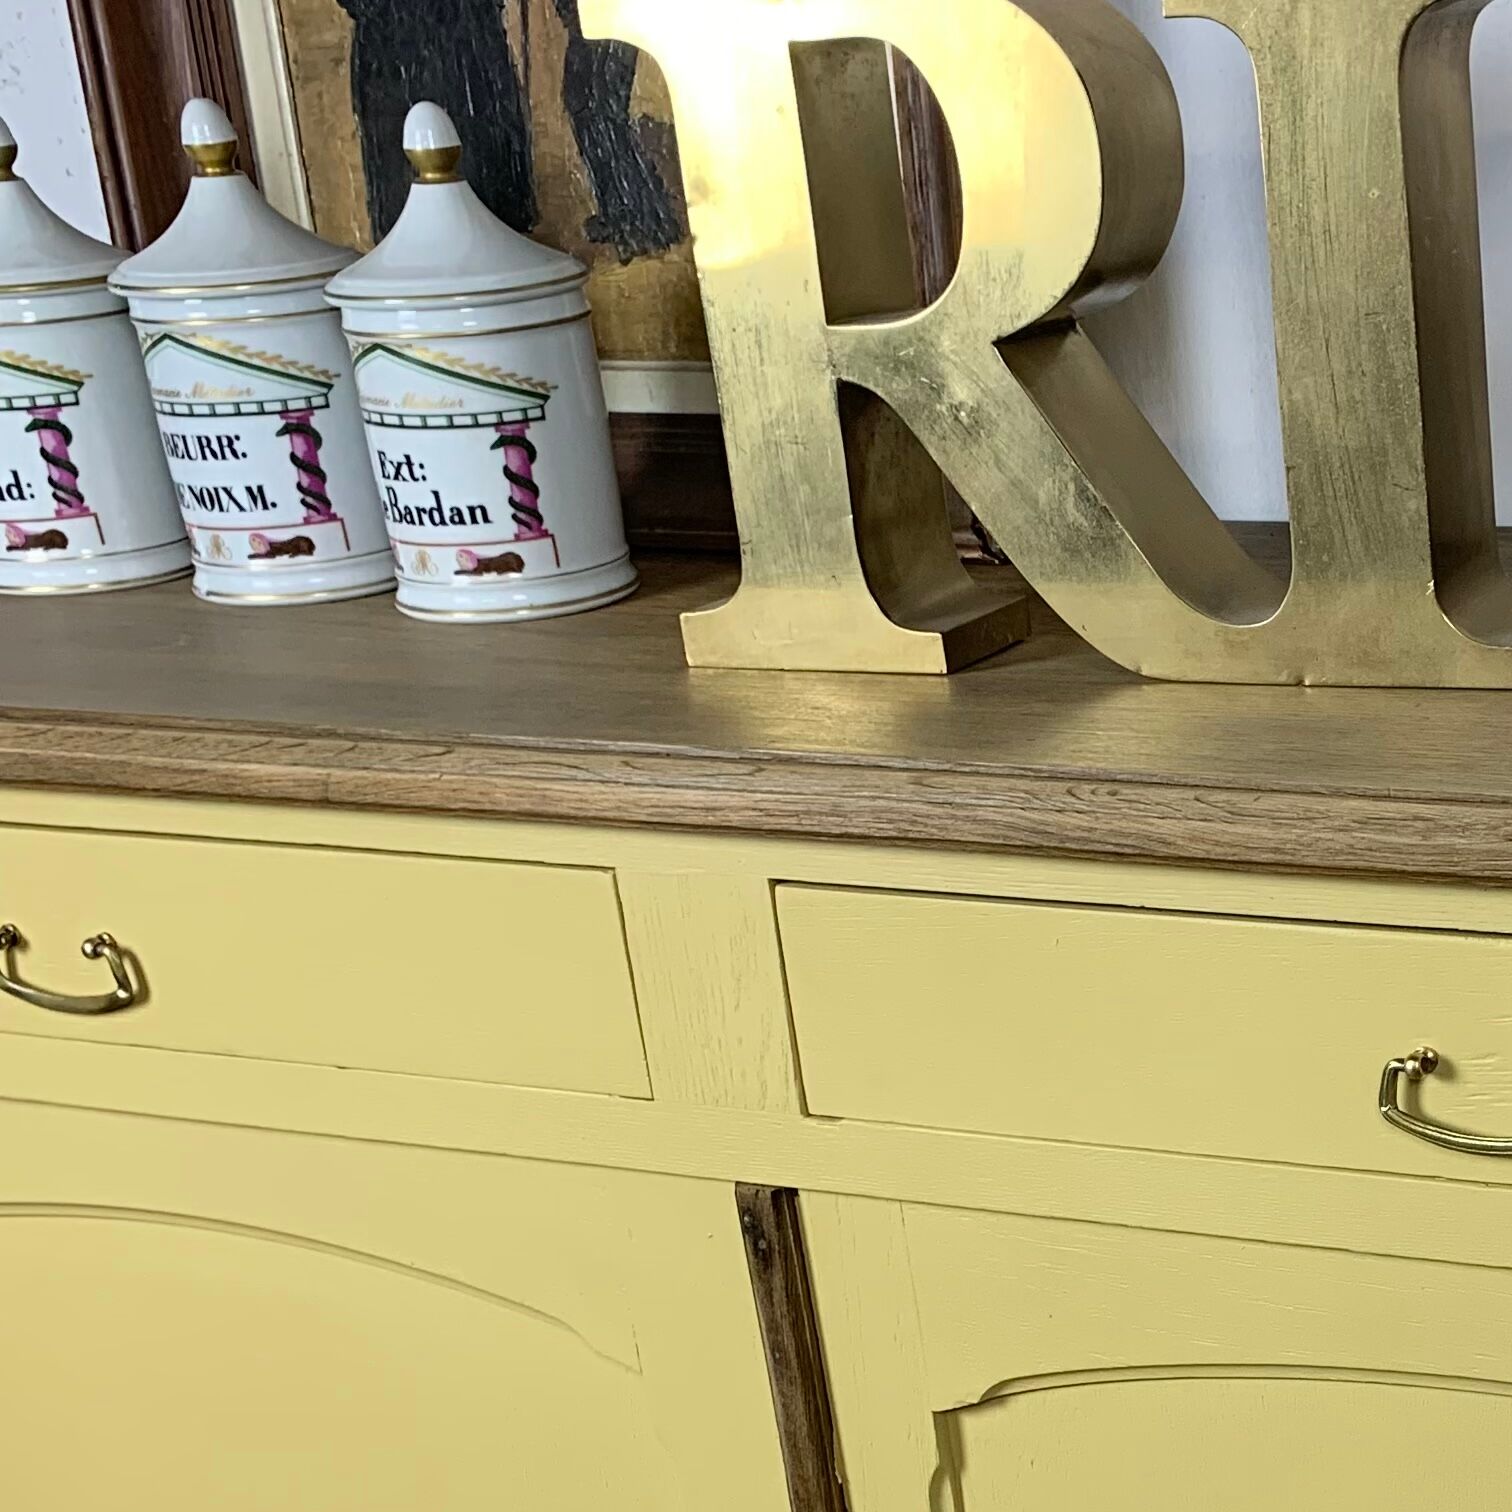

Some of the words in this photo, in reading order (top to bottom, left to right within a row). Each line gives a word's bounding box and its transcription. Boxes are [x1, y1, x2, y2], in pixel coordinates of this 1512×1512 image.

[377, 450, 427, 482] Ext:
[187, 484, 247, 513] NOIX
[244, 484, 278, 513] M.
[385, 485, 494, 527] Bardan
